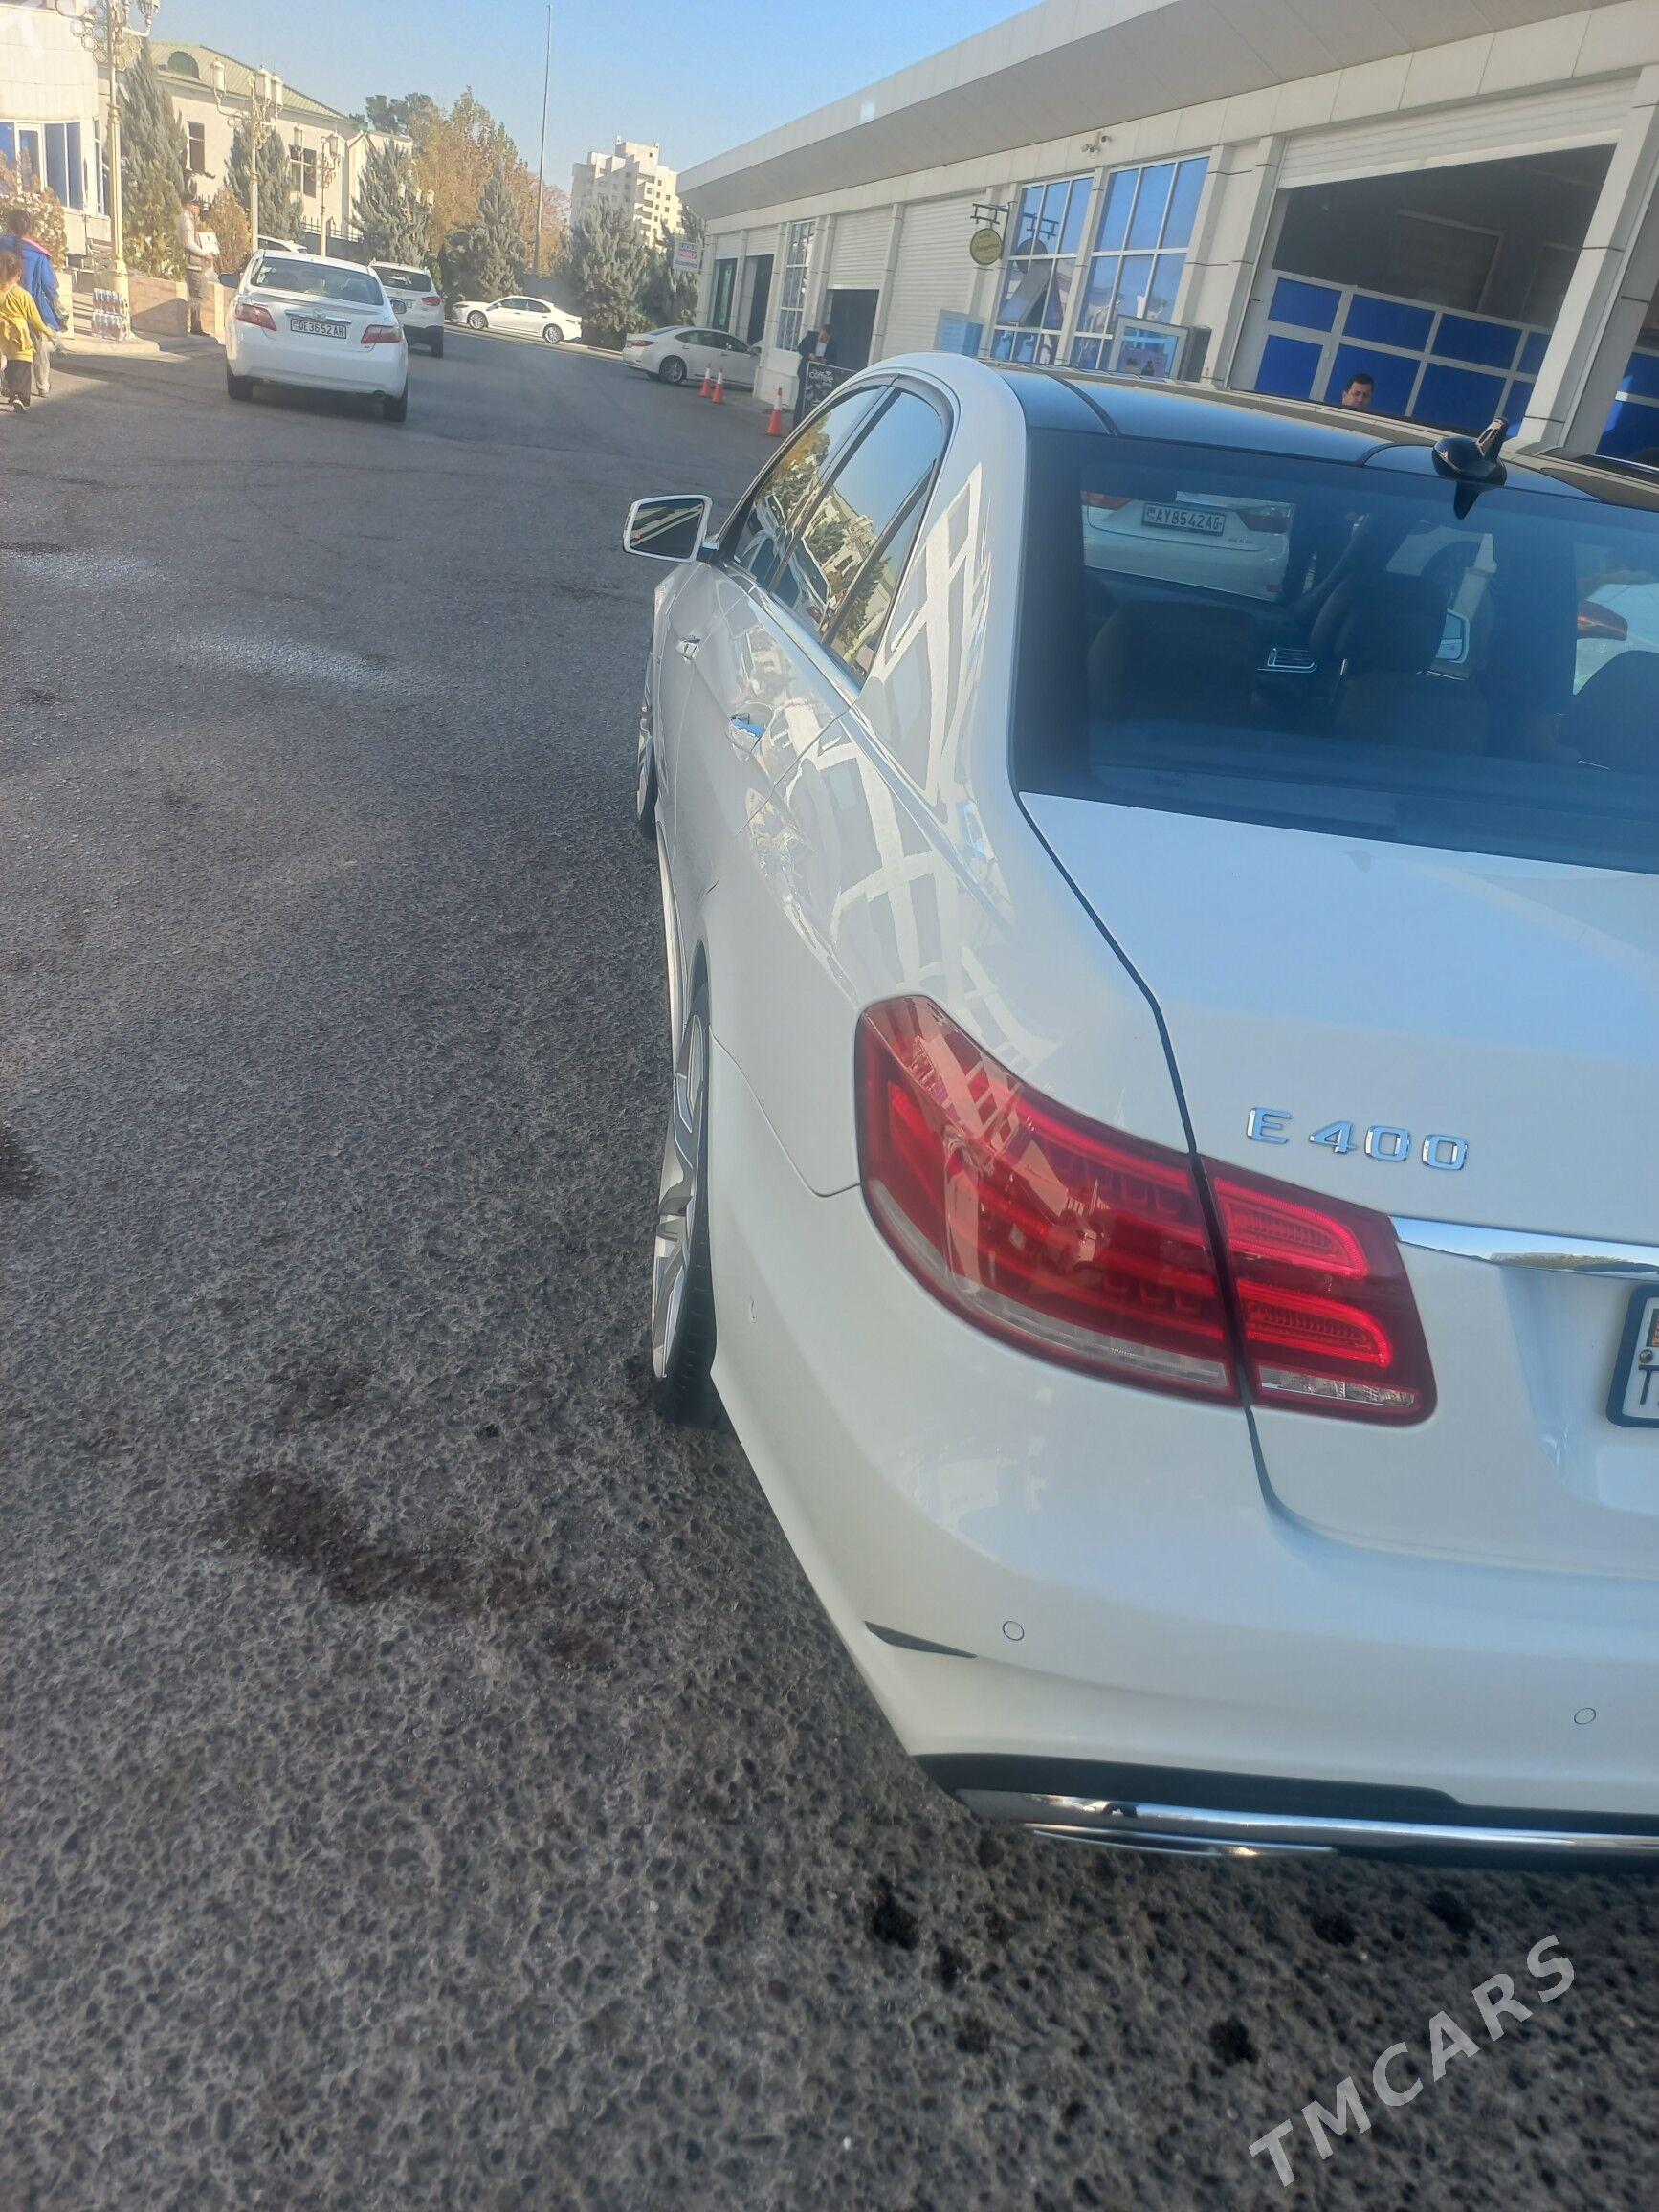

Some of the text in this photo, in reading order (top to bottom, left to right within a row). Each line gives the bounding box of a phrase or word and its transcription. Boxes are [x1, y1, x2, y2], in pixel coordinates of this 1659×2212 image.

[1246, 1107, 1468, 1171] E 400
[1637, 1364, 1659, 1405] T
